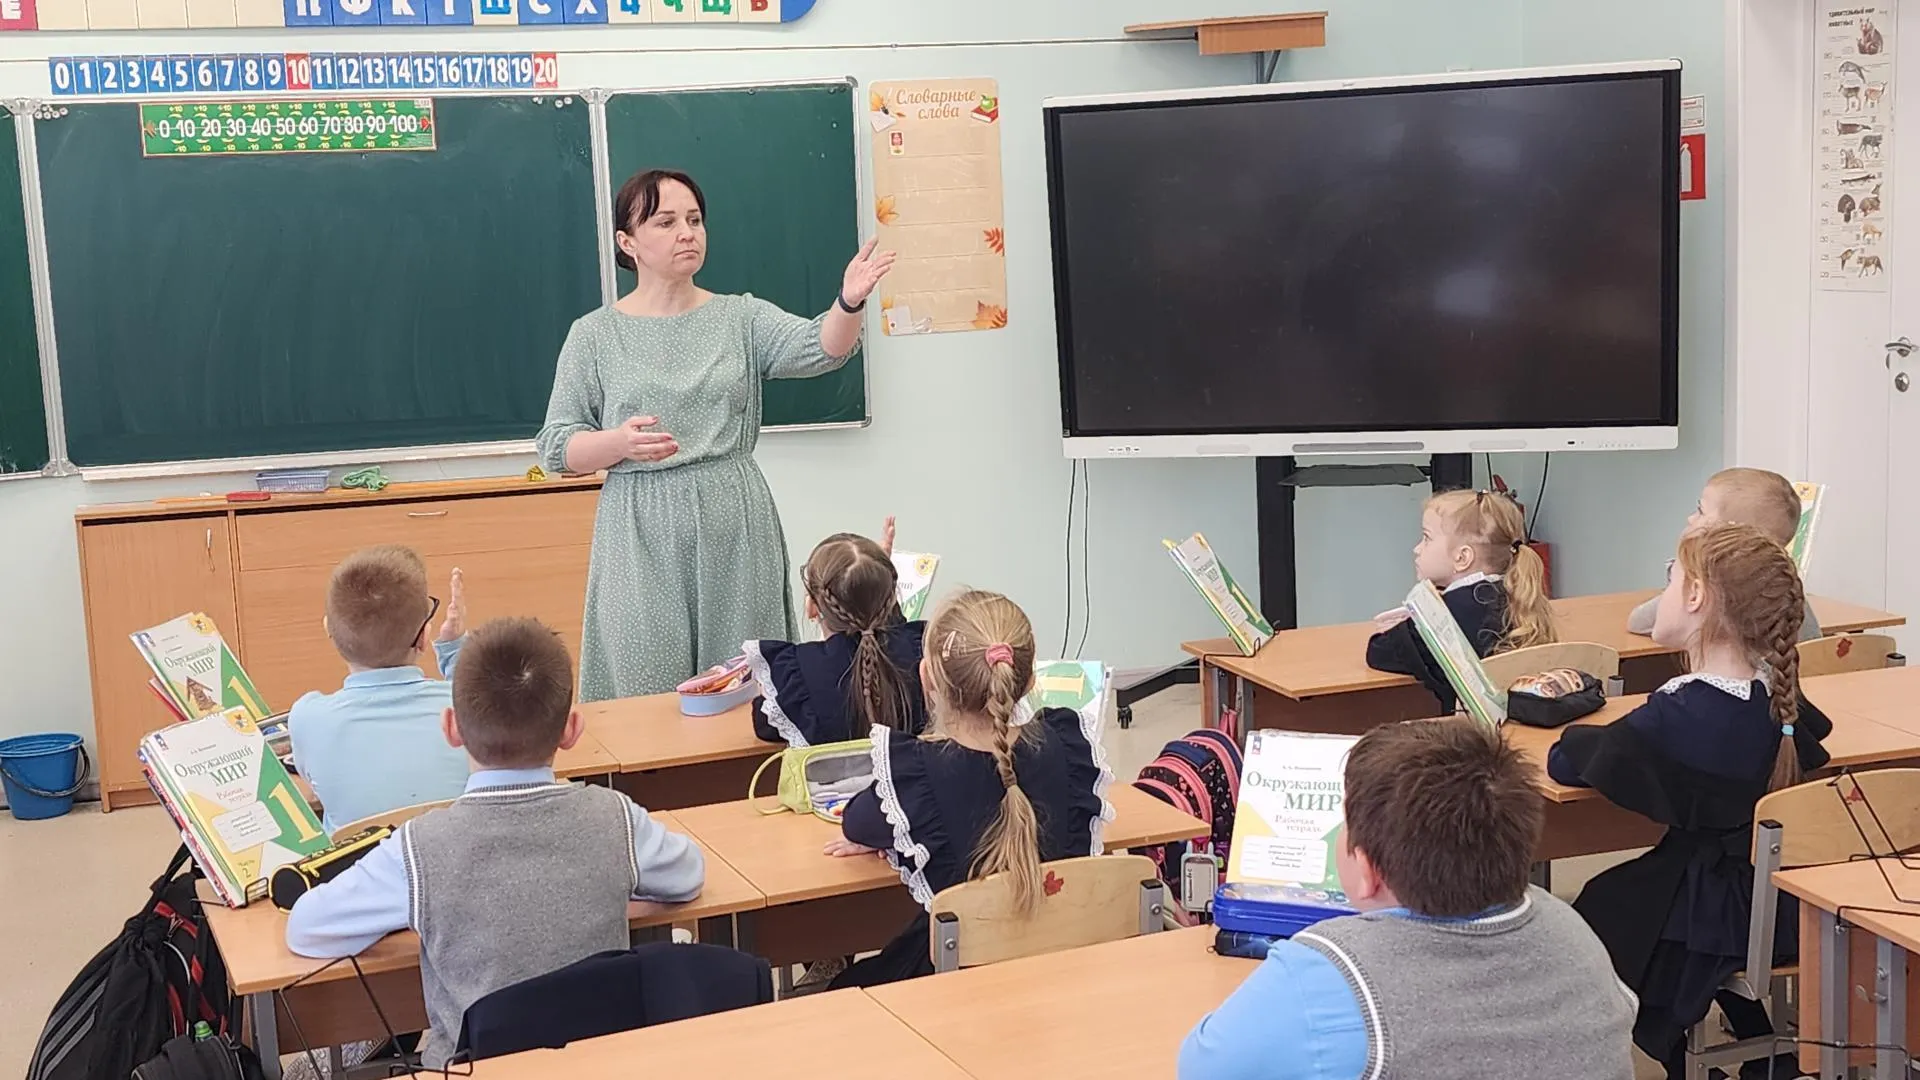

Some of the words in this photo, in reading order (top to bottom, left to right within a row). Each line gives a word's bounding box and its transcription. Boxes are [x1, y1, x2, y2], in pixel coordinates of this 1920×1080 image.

[55, 63, 69, 89] 0
[79, 63, 91, 88] 1
[103, 62, 118, 88] 2
[128, 62, 141, 88] 3
[151, 61, 165, 87] 4
[175, 61, 188, 87] 5
[199, 60, 212, 86] 6
[221, 60, 234, 86] 7
[245, 60, 258, 86] 8
[268, 59, 281, 85] 9
[288, 59, 309, 84] 10
[312, 59, 332, 84] 11
[338, 58, 360, 83] 12
[363, 58, 385, 83] 13
[389, 58, 411, 83] 14
[414, 58, 435, 83] 15
[438, 58, 460, 83] 16
[462, 58, 483, 82] 17
[487, 58, 508, 82] 18
[512, 58, 531, 82] 19
[536, 58, 555, 82] 20
[896, 88, 976, 107] Словарные
[918, 103, 959, 119] слова
[160, 120, 169, 138] 0
[176, 119, 195, 137] 10
[201, 119, 221, 137] 20
[226, 118, 246, 136] 30
[251, 118, 271, 136] 40
[276, 118, 295, 135] 50
[299, 117, 318, 135] 60
[321, 116, 340, 134] 70
[345, 116, 363, 133] 80
[366, 116, 385, 133] 90
[389, 115, 417, 132] 100
[188, 657, 215, 676] МИР
[227, 676, 264, 721] 1
[174, 745, 254, 777] Окружающий
[210, 761, 248, 787] МИР
[1247, 771, 1341, 792] Окружающ
[268, 781, 323, 843] 1
[1283, 792, 1342, 811] МИР
[242, 867, 251, 878] 2
